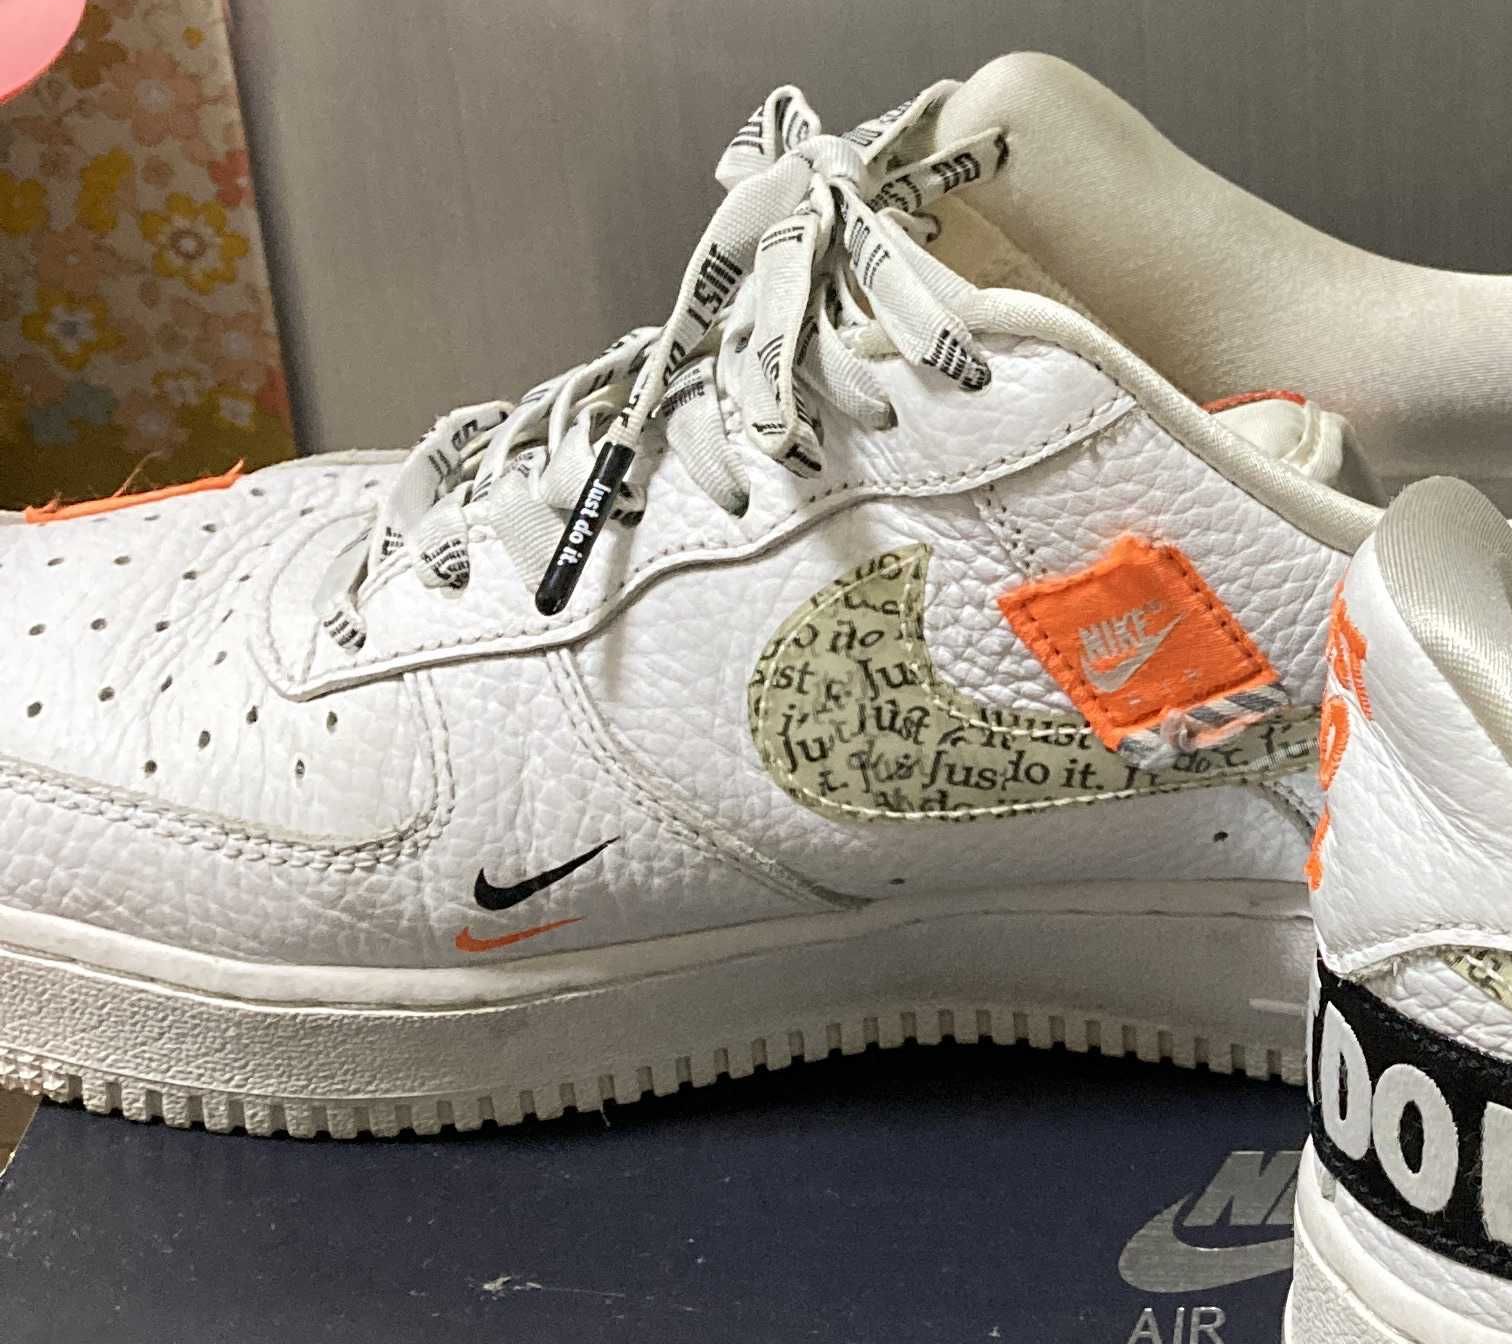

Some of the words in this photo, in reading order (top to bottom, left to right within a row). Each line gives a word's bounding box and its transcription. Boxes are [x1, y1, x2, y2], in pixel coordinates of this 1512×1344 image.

[579, 478, 612, 519] Just
[568, 519, 594, 545] do
[557, 546, 583, 567] it.
[1078, 607, 1148, 662] NIKE
[1059, 758, 1105, 791] it.
[1321, 1000, 1460, 1214] DO
